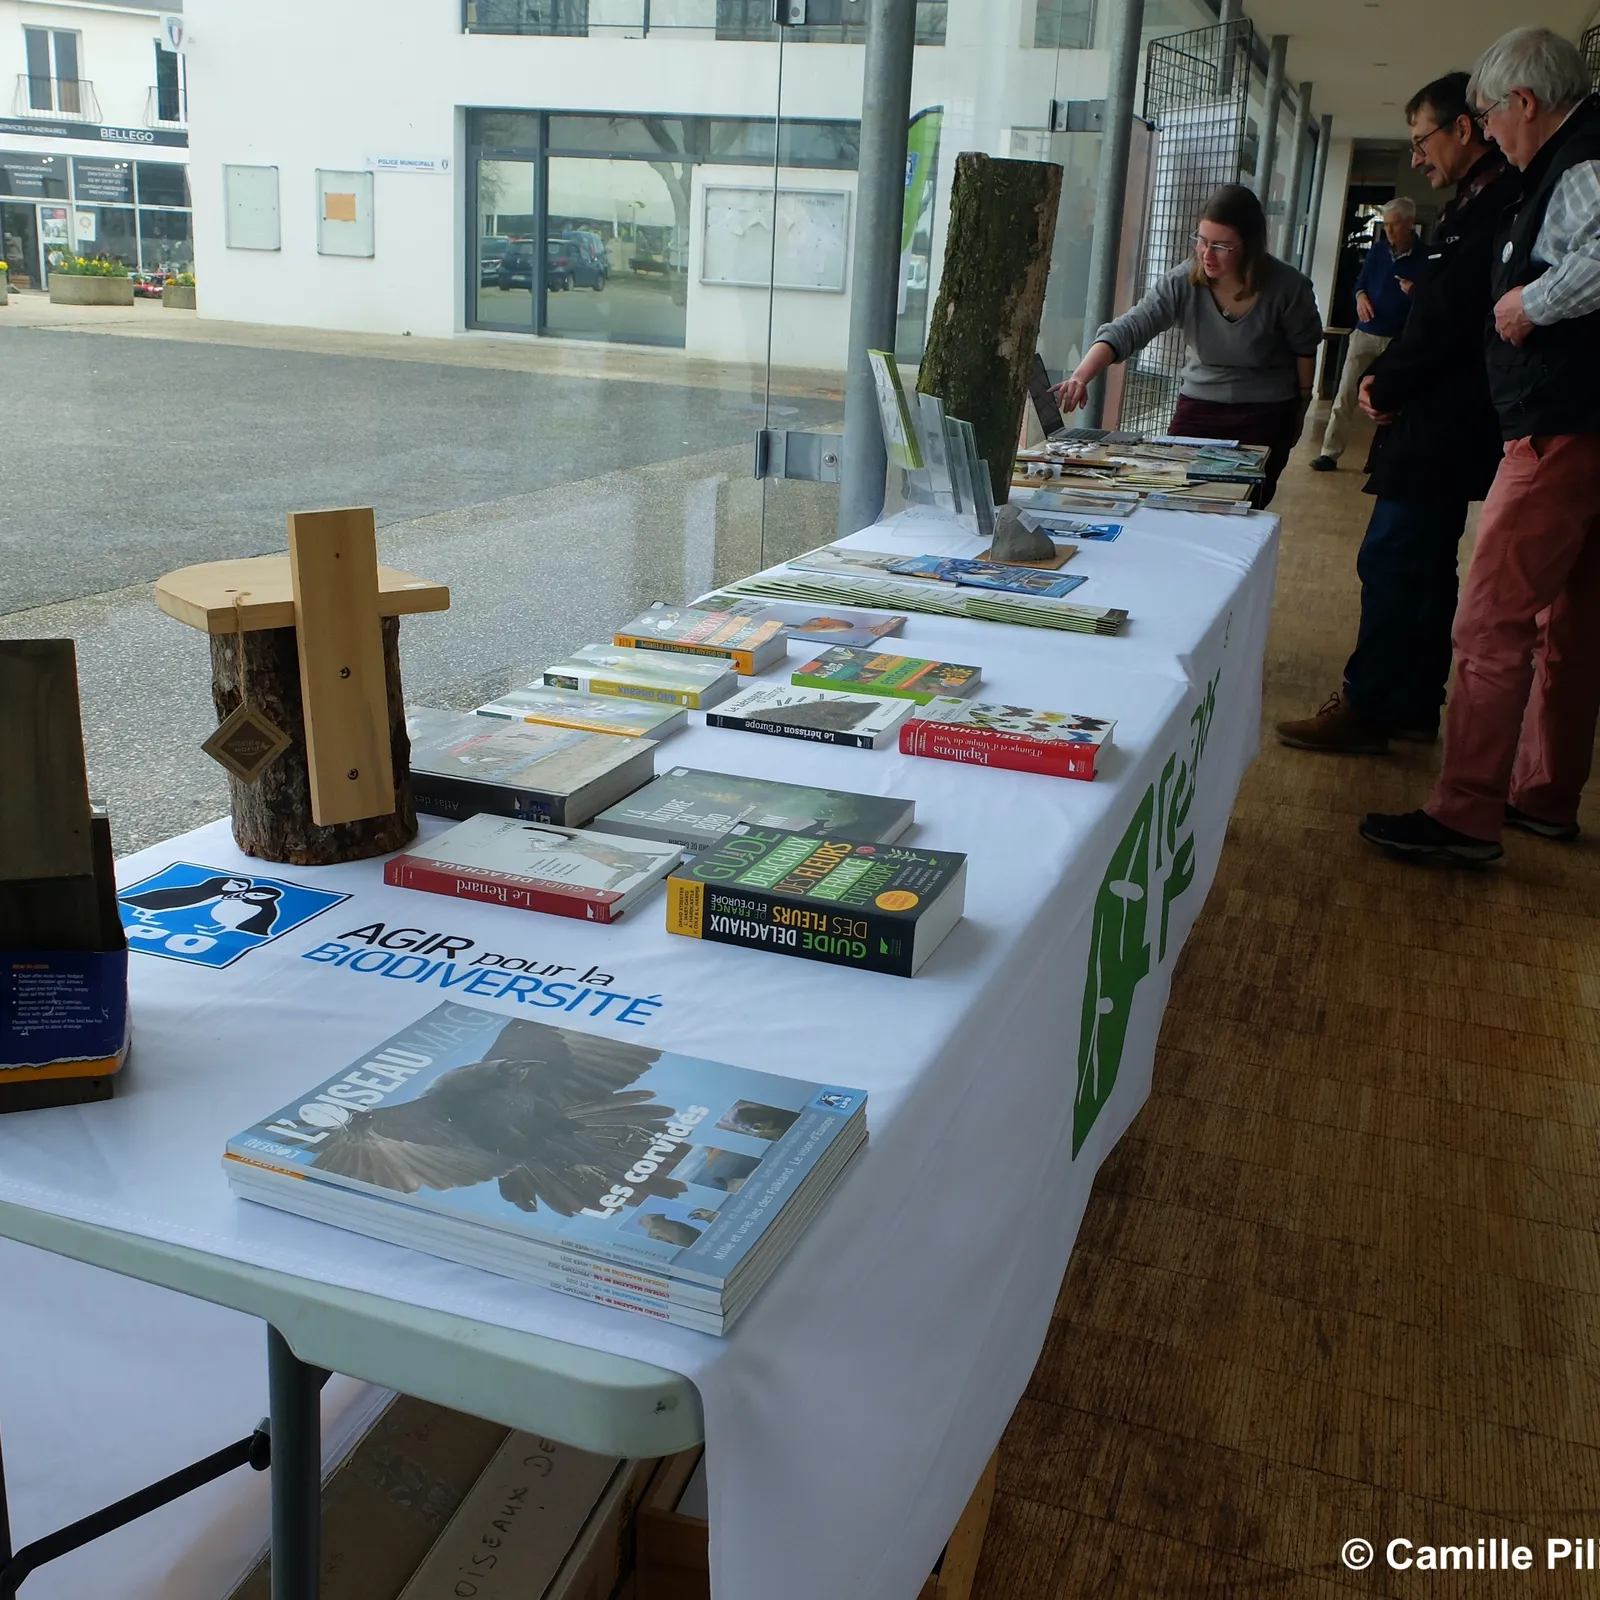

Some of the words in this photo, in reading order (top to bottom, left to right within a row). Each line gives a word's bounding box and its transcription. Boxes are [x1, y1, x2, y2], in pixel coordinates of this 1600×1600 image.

[100, 128, 154, 142] BELLEGO
[400, 160, 435, 168] MUNICIPALE
[881, 660, 921, 685] entomo
[745, 720, 782, 735] d'Europe
[783, 726, 822, 740] hérisson
[928, 723, 1023, 741] DELACHAUX
[824, 732, 835, 742] Le
[933, 735, 952, 745] Nord
[964, 738, 998, 752] d'Afrique
[1026, 734, 1070, 748] GUIDE
[933, 745, 989, 764] Papillons
[1007, 746, 1043, 758] d'Europe
[414, 795, 431, 806] des
[435, 798, 460, 811] Atlas
[621, 808, 651, 819] LA
[645, 798, 695, 823] NATURE
[674, 813, 704, 824] EN
[692, 813, 732, 831] BORD
[692, 831, 782, 881] GUIDE
[740, 836, 819, 888] DELACHAUX
[431, 860, 535, 886] DELACHAUX
[773, 870, 815, 895] DES
[800, 841, 853, 882] FLEURS
[818, 857, 867, 888] FRANCE
[537, 878, 586, 893] GUIDE
[846, 861, 901, 896] D'EUROPE
[455, 880, 508, 902] Renard
[512, 889, 532, 906] Le
[806, 884, 839, 900] DE
[840, 888, 866, 906] ET
[710, 894, 755, 909] D'EUROPE
[755, 901, 768, 912] ET
[710, 903, 752, 917] FRANCE
[772, 905, 828, 930] FLEURS
[710, 914, 797, 947] DELACHAUX
[832, 917, 868, 940] DES
[124, 925, 218, 954] PO
[802, 931, 868, 959] GUIDE
[337, 922, 476, 959] AGIR
[469, 952, 577, 977] pour
[577, 965, 615, 987] la
[301, 942, 664, 1026] BIODIVERSITÉ
[243, 1138, 302, 1160] L'OISEAU
[581, 1183, 634, 1220] Les
[624, 1103, 711, 1184] corvidés
[713, 1240, 737, 1261] Mille
[730, 1233, 742, 1244] et
[737, 1218, 754, 1235] une
[757, 1193, 774, 1208] des
[766, 1167, 795, 1199] Falkland
[789, 1156, 803, 1167] Le
[798, 1140, 816, 1161] vison
[809, 1116, 837, 1142] d'Europe
[573, 1258, 589, 1267] HIVER
[561, 1265, 590, 1278] PRINTEMPS
[611, 1269, 643, 1282] MAGAZINE
[562, 1286, 591, 1298] PRINTEMPS
[612, 1279, 643, 1292] MAGAZINE
[643, 1287, 670, 1299] L'OISEAU
[613, 1299, 644, 1313] MAGAZINE
[644, 1309, 670, 1320] L'OISEAU
[454, 1486, 529, 1598] OISEAUX
